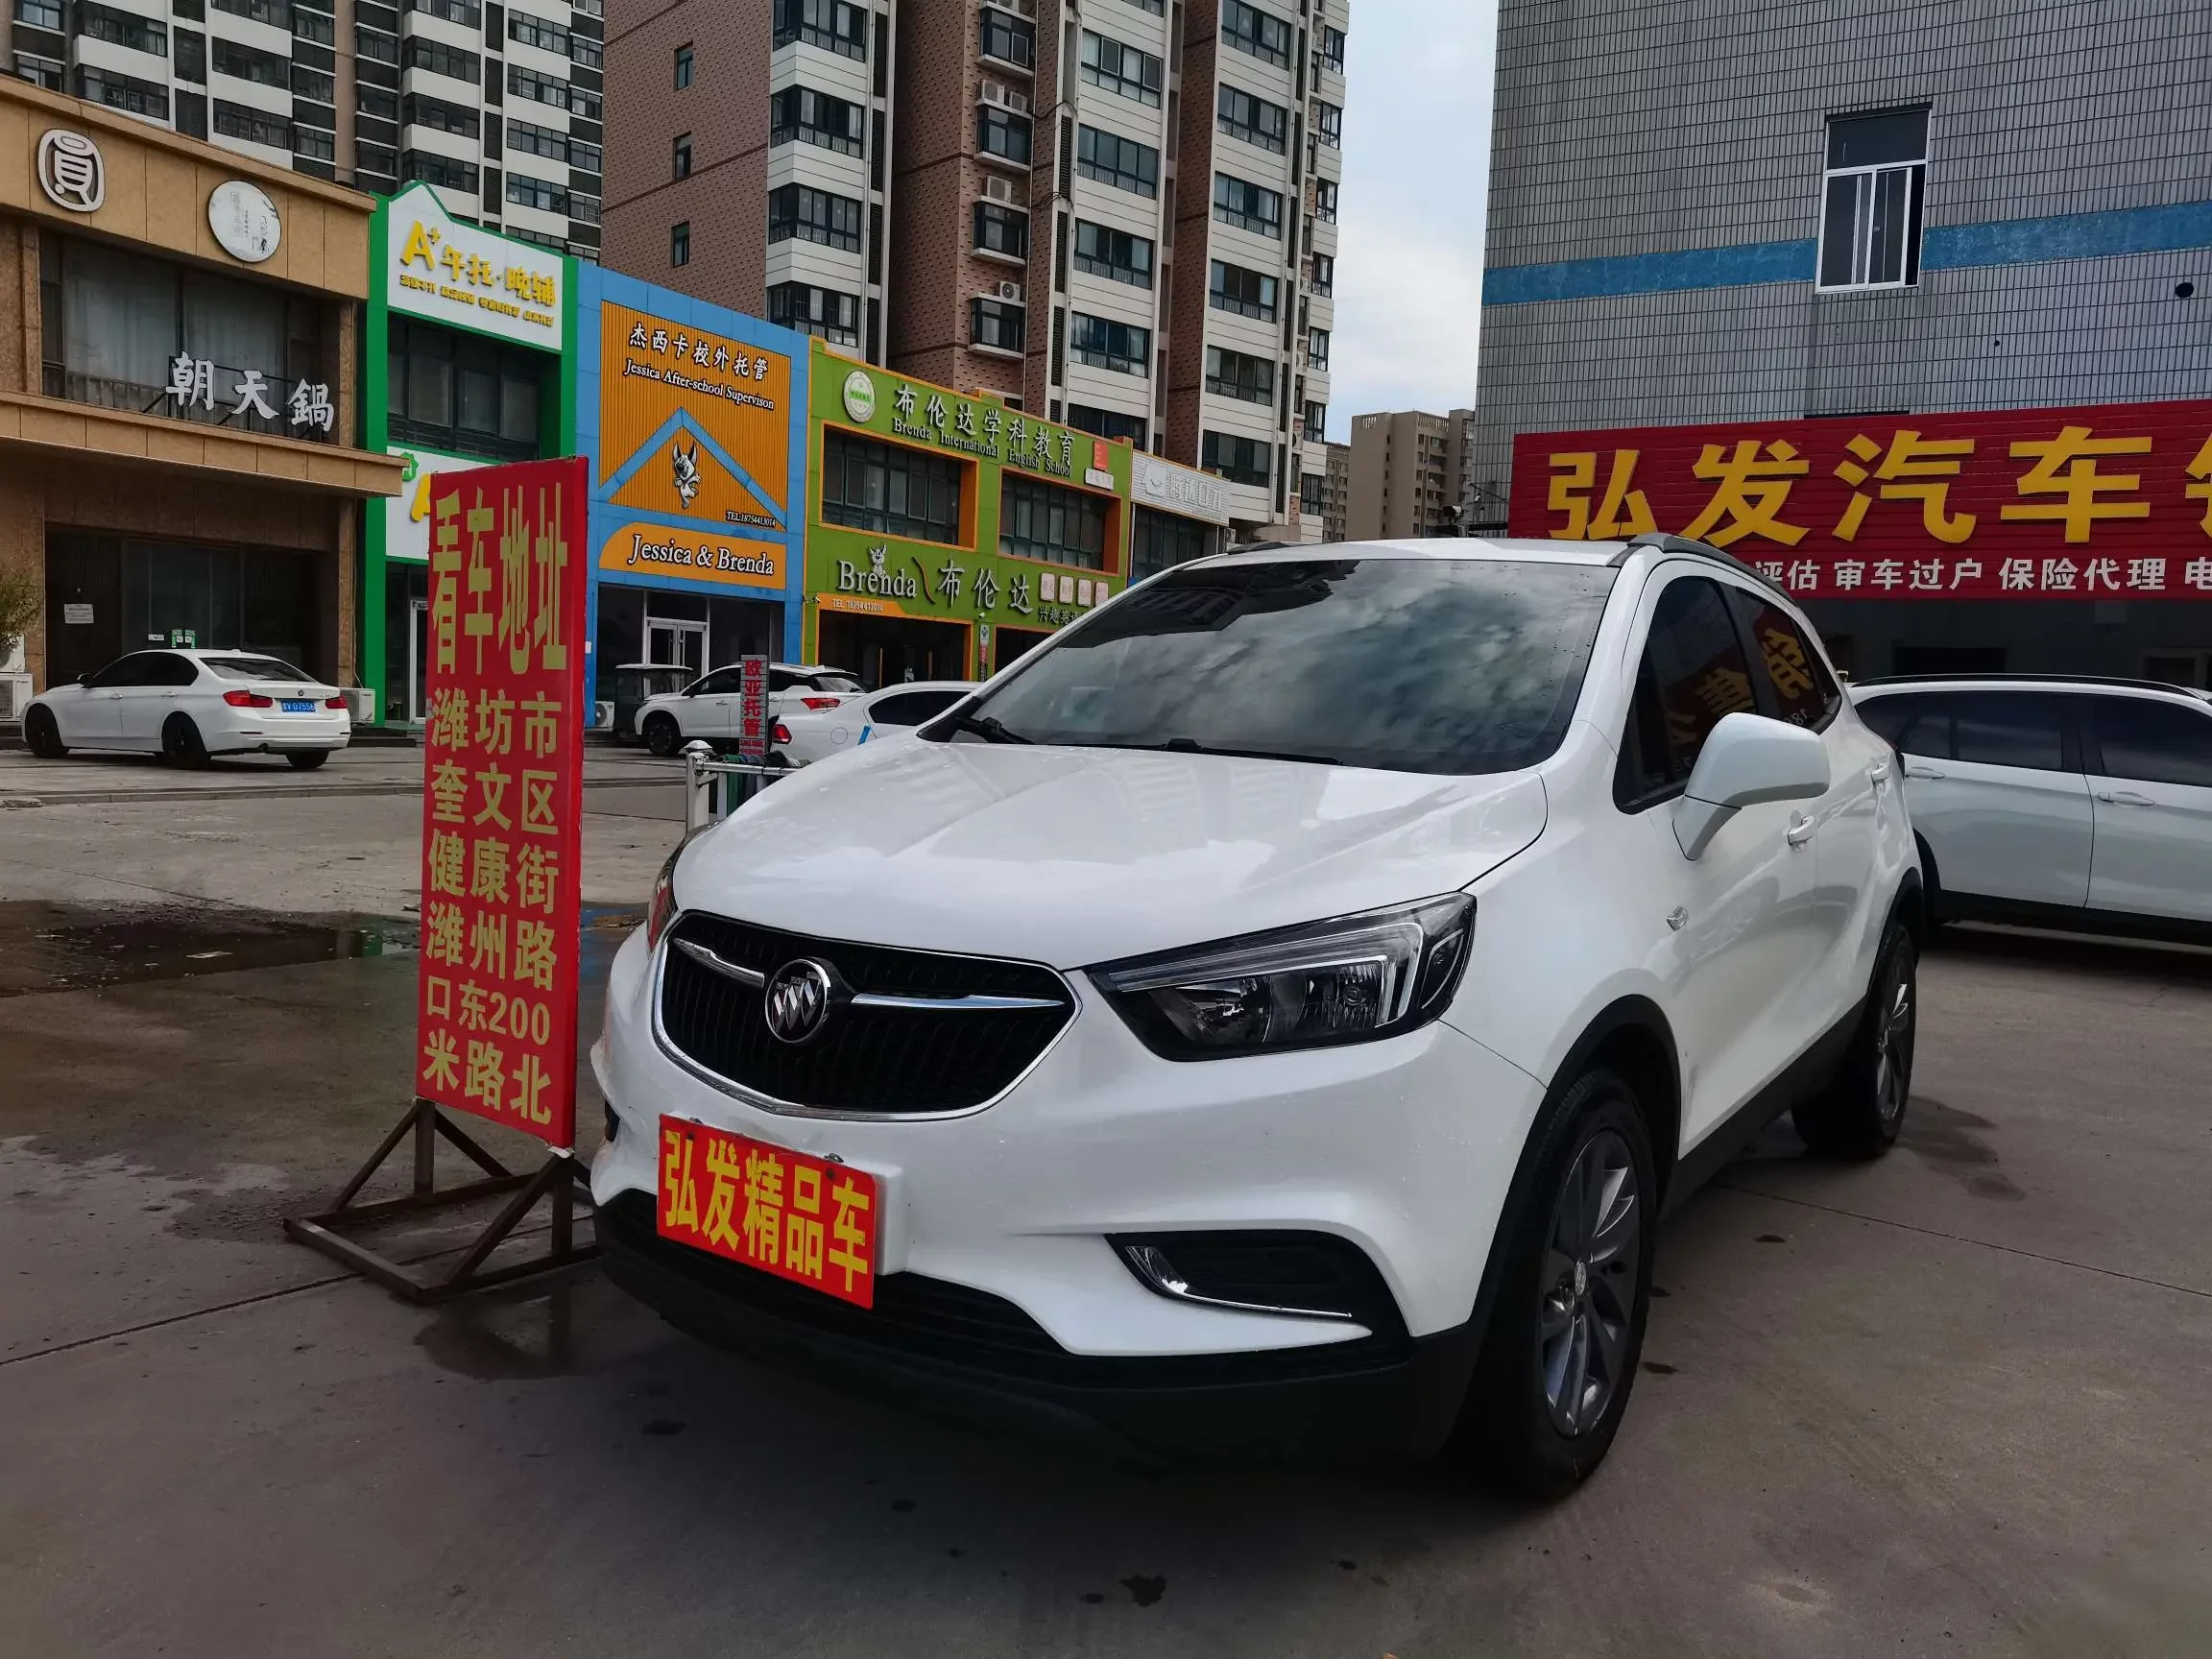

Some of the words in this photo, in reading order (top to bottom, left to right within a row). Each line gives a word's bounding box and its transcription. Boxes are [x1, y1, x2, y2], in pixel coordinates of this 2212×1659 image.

[624, 359, 661, 380] Jessica
[663, 370, 724, 397] After-school
[725, 386, 774, 410] Supervison
[630, 323, 769, 381] 杰西卡校外托管
[894, 383, 1074, 466] 布伦达学科教育
[894, 418, 931, 441] Brenda
[940, 430, 999, 458] International
[1008, 449, 1040, 469] English
[1045, 459, 1072, 478] School
[1548, 425, 2212, 548] 弘发汽车
[432, 482, 568, 675] 看车地址
[628, 534, 692, 565] Jessica
[696, 545, 712, 567] &
[717, 547, 775, 575] Brenda
[837, 560, 917, 599] Brenda
[937, 560, 1034, 615] 布伦达
[1834, 560, 1984, 591] 审车过户
[1998, 557, 2167, 591] 保险代理
[430, 687, 562, 758] 潍坊市
[430, 759, 559, 836] 奎文区
[428, 829, 559, 913] 健康街
[425, 900, 557, 991] 潍州路
[426, 976, 551, 1046] 口东200
[422, 1028, 552, 1125] 米路北
[664, 1129, 870, 1293] 弘发精品车
